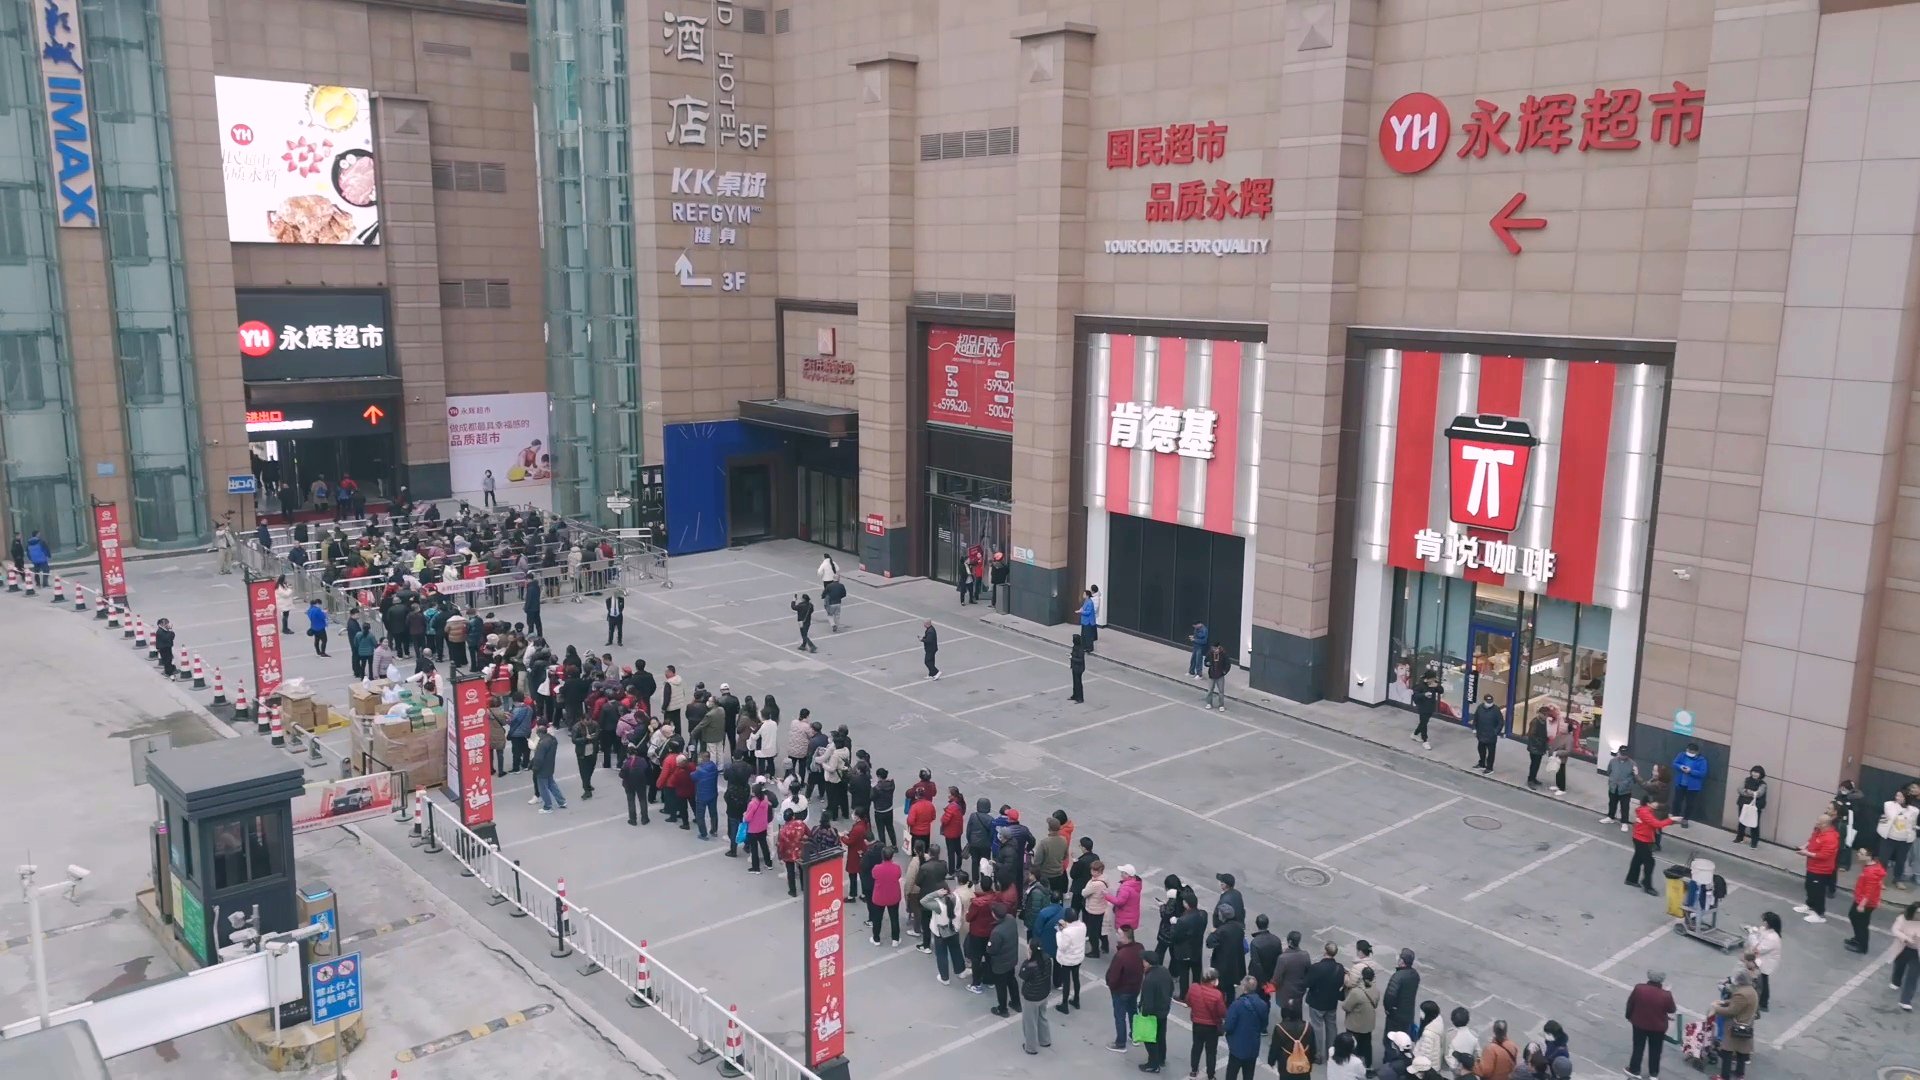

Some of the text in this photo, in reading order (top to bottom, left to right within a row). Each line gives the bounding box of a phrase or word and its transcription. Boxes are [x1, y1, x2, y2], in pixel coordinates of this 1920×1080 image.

[663, 10, 711, 145] 酒店
[716, 0, 736, 146] D HOTEL
[1390, 80, 1706, 159] YH 永辉超市
[232, 128, 251, 141] YH
[738, 122, 768, 148] 5F
[1106, 120, 1228, 170] 国民超市
[47, 76, 97, 224] IMAX
[670, 166, 767, 199] KK桌球
[672, 202, 751, 224] REFGYM
[1145, 177, 1274, 224] 品质永辉
[693, 226, 737, 245] 健身
[1104, 238, 1271, 257] YOUR CHOICE FOR QUALITY
[721, 271, 747, 292] 3F
[240, 323, 385, 351] YH 永辉超市
[461, 406, 491, 415] 永辉超市
[450, 420, 530, 433] 做成都最具幸福感的
[450, 432, 501, 447] 品质超市
[1109, 402, 1218, 460] 肯德基
[1414, 528, 1556, 583] 肯悦咖啡
